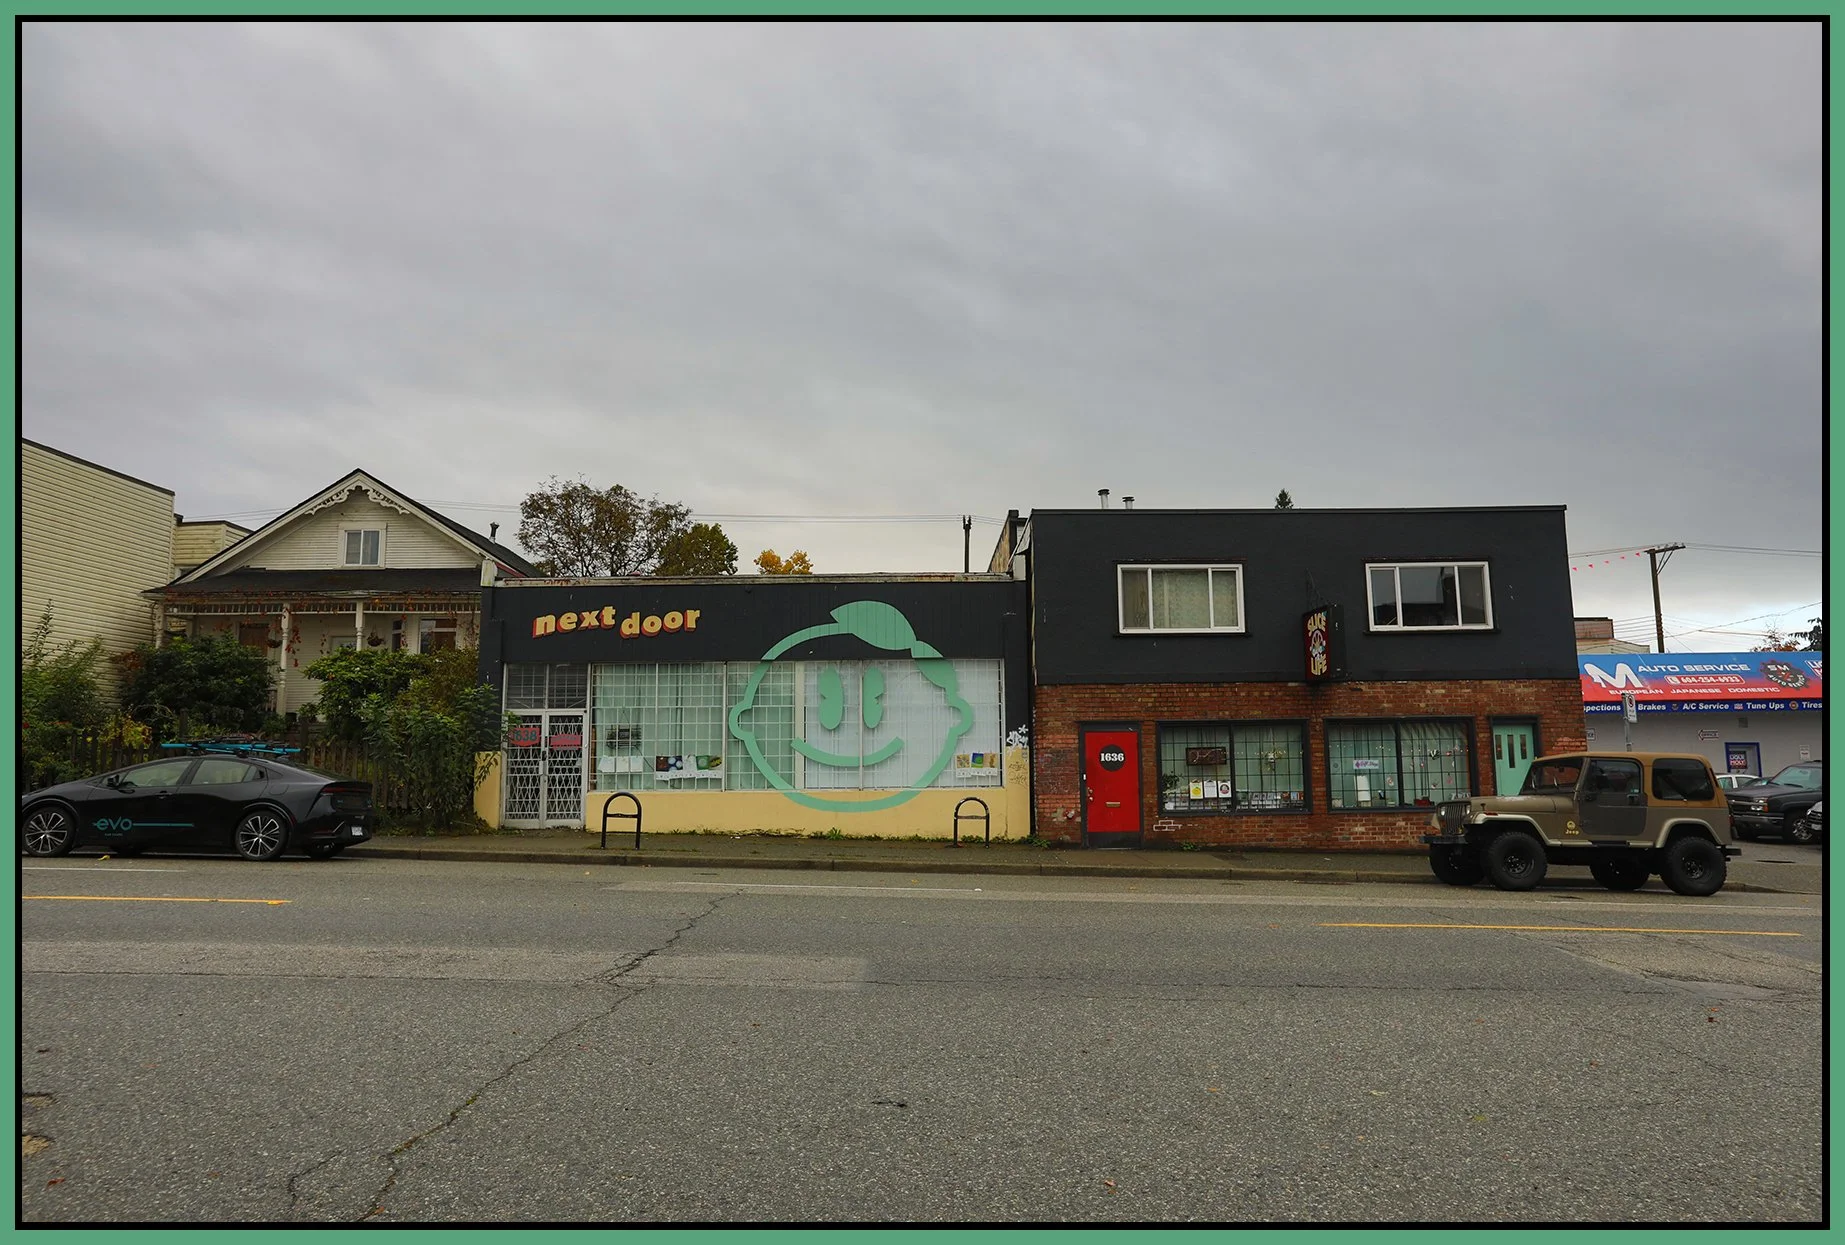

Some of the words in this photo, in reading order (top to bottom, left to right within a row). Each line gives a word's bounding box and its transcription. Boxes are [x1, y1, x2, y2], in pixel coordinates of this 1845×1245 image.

[532, 605, 616, 638] next
[619, 609, 701, 639] door
[1307, 611, 1327, 637] SLICE
[1310, 653, 1328, 676] LIFE
[1683, 664, 1751, 672] SERVICE
[1583, 704, 1621, 712] pections
[1769, 702, 1785, 710] Ups
[1100, 752, 1125, 762] 1636
[95, 816, 132, 831] evo
